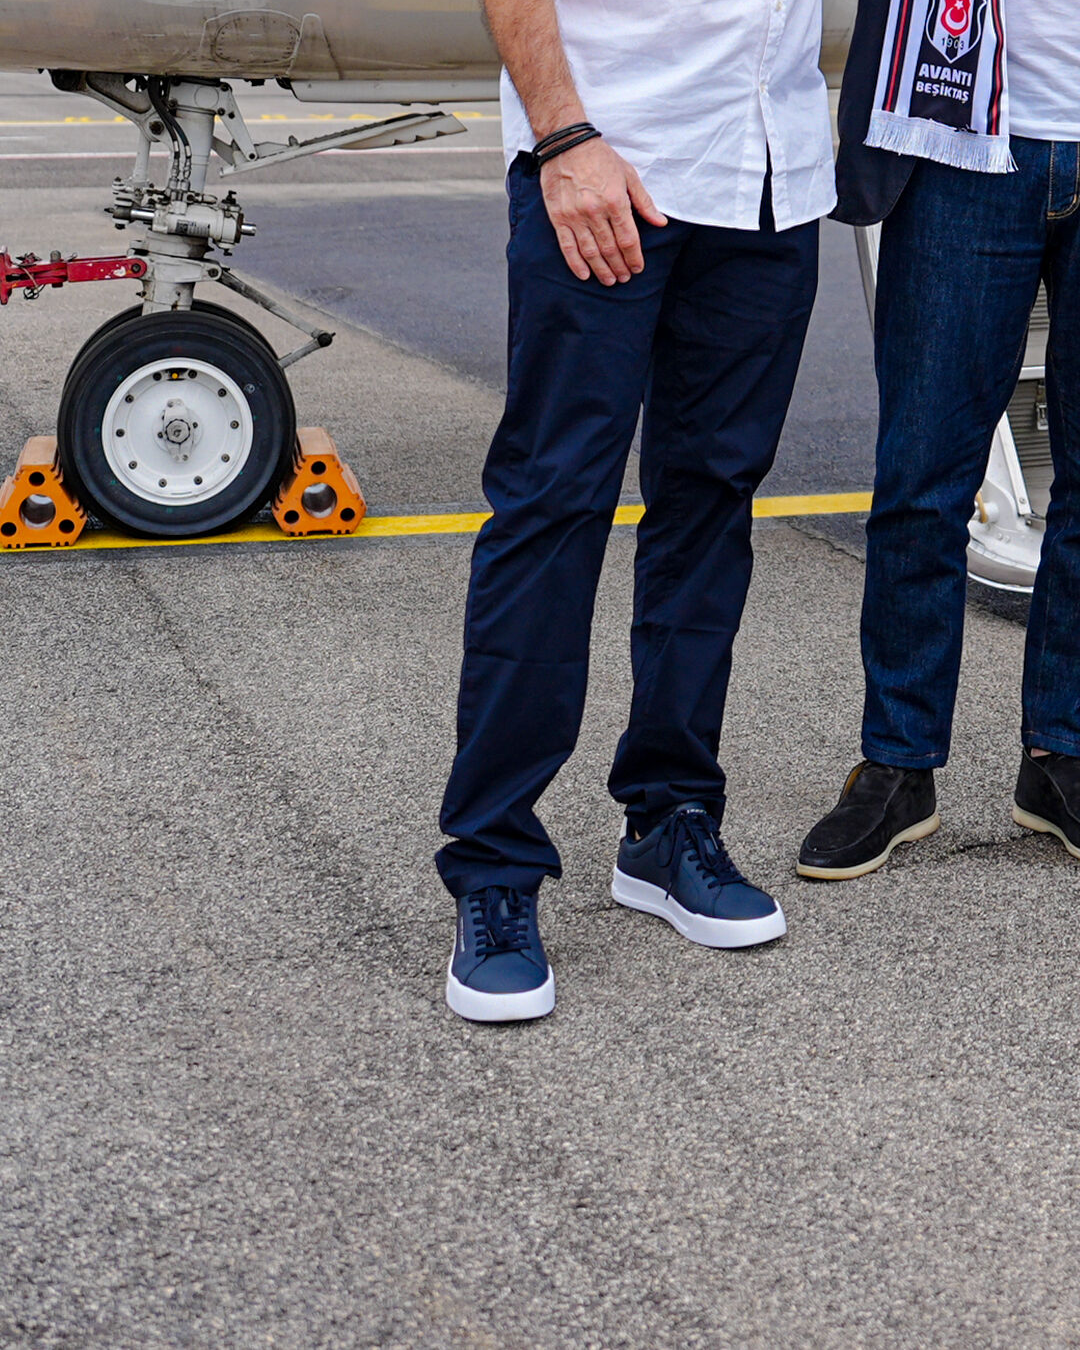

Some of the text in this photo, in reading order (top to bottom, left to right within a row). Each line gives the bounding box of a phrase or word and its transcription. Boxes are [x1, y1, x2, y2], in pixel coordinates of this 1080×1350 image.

[941, 37, 965, 50] 1903
[918, 62, 973, 87] AVANTI
[915, 81, 970, 104] BEŞİKTAŞ
